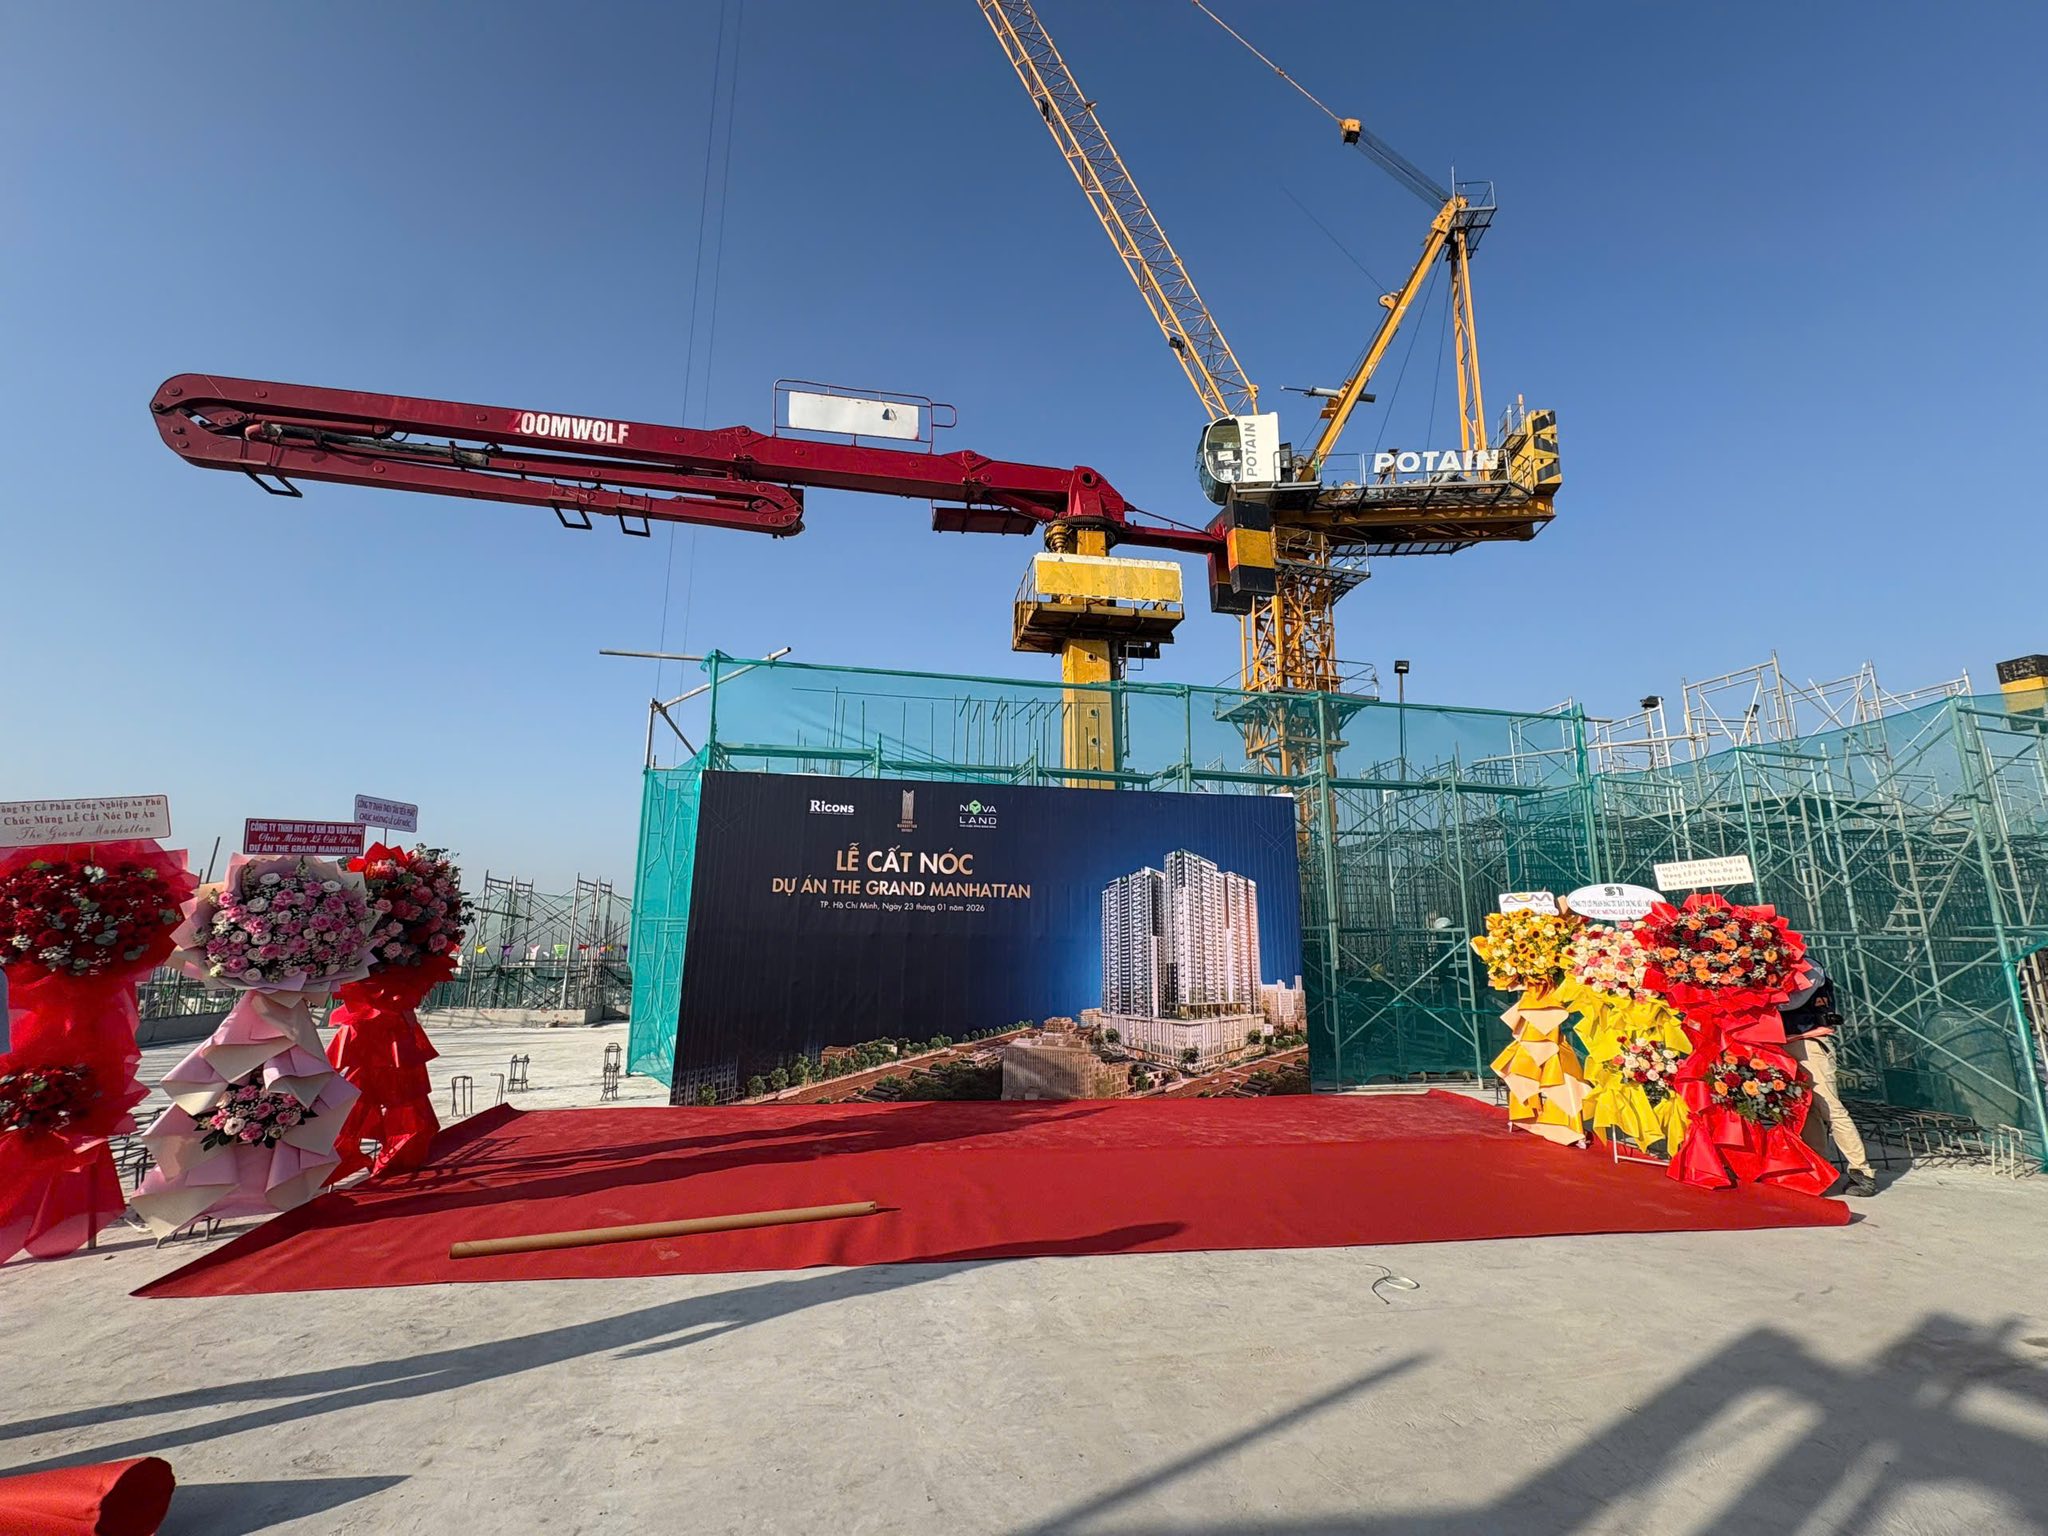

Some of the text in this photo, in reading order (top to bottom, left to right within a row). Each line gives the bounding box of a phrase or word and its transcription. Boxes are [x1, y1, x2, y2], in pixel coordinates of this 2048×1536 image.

[1244, 422, 1258, 477] POTAIN
[1373, 450, 1499, 473] POTAIN
[0, 805, 18, 814] ông
[21, 804, 31, 813] Ty
[35, 803, 47, 812] Cổ
[50, 801, 71, 811] Phần
[99, 801, 129, 809] Nghiệp
[4, 816, 31, 826] Chúc
[34, 815, 63, 824] Mừng
[66, 811, 79, 823] Lễ
[82, 810, 99, 822] Cất
[103, 811, 121, 821] Nóc
[125, 811, 138, 821] Dự
[959, 816, 997, 826] LAND
[269, 823, 276, 832] TY
[249, 843, 261, 853] DỰ
[262, 843, 273, 852] ÁN
[291, 845, 316, 853] GRAND
[318, 846, 359, 854] MANHATTAN
[836, 842, 974, 875] LỄ CẤT NÓC
[772, 874, 1031, 900] DỰ ÁN THE GRAND MANHATTAN
[820, 901, 985, 913] TP. Hồ Chí Minh, Ngày 23 tháng 01 năm 2026
